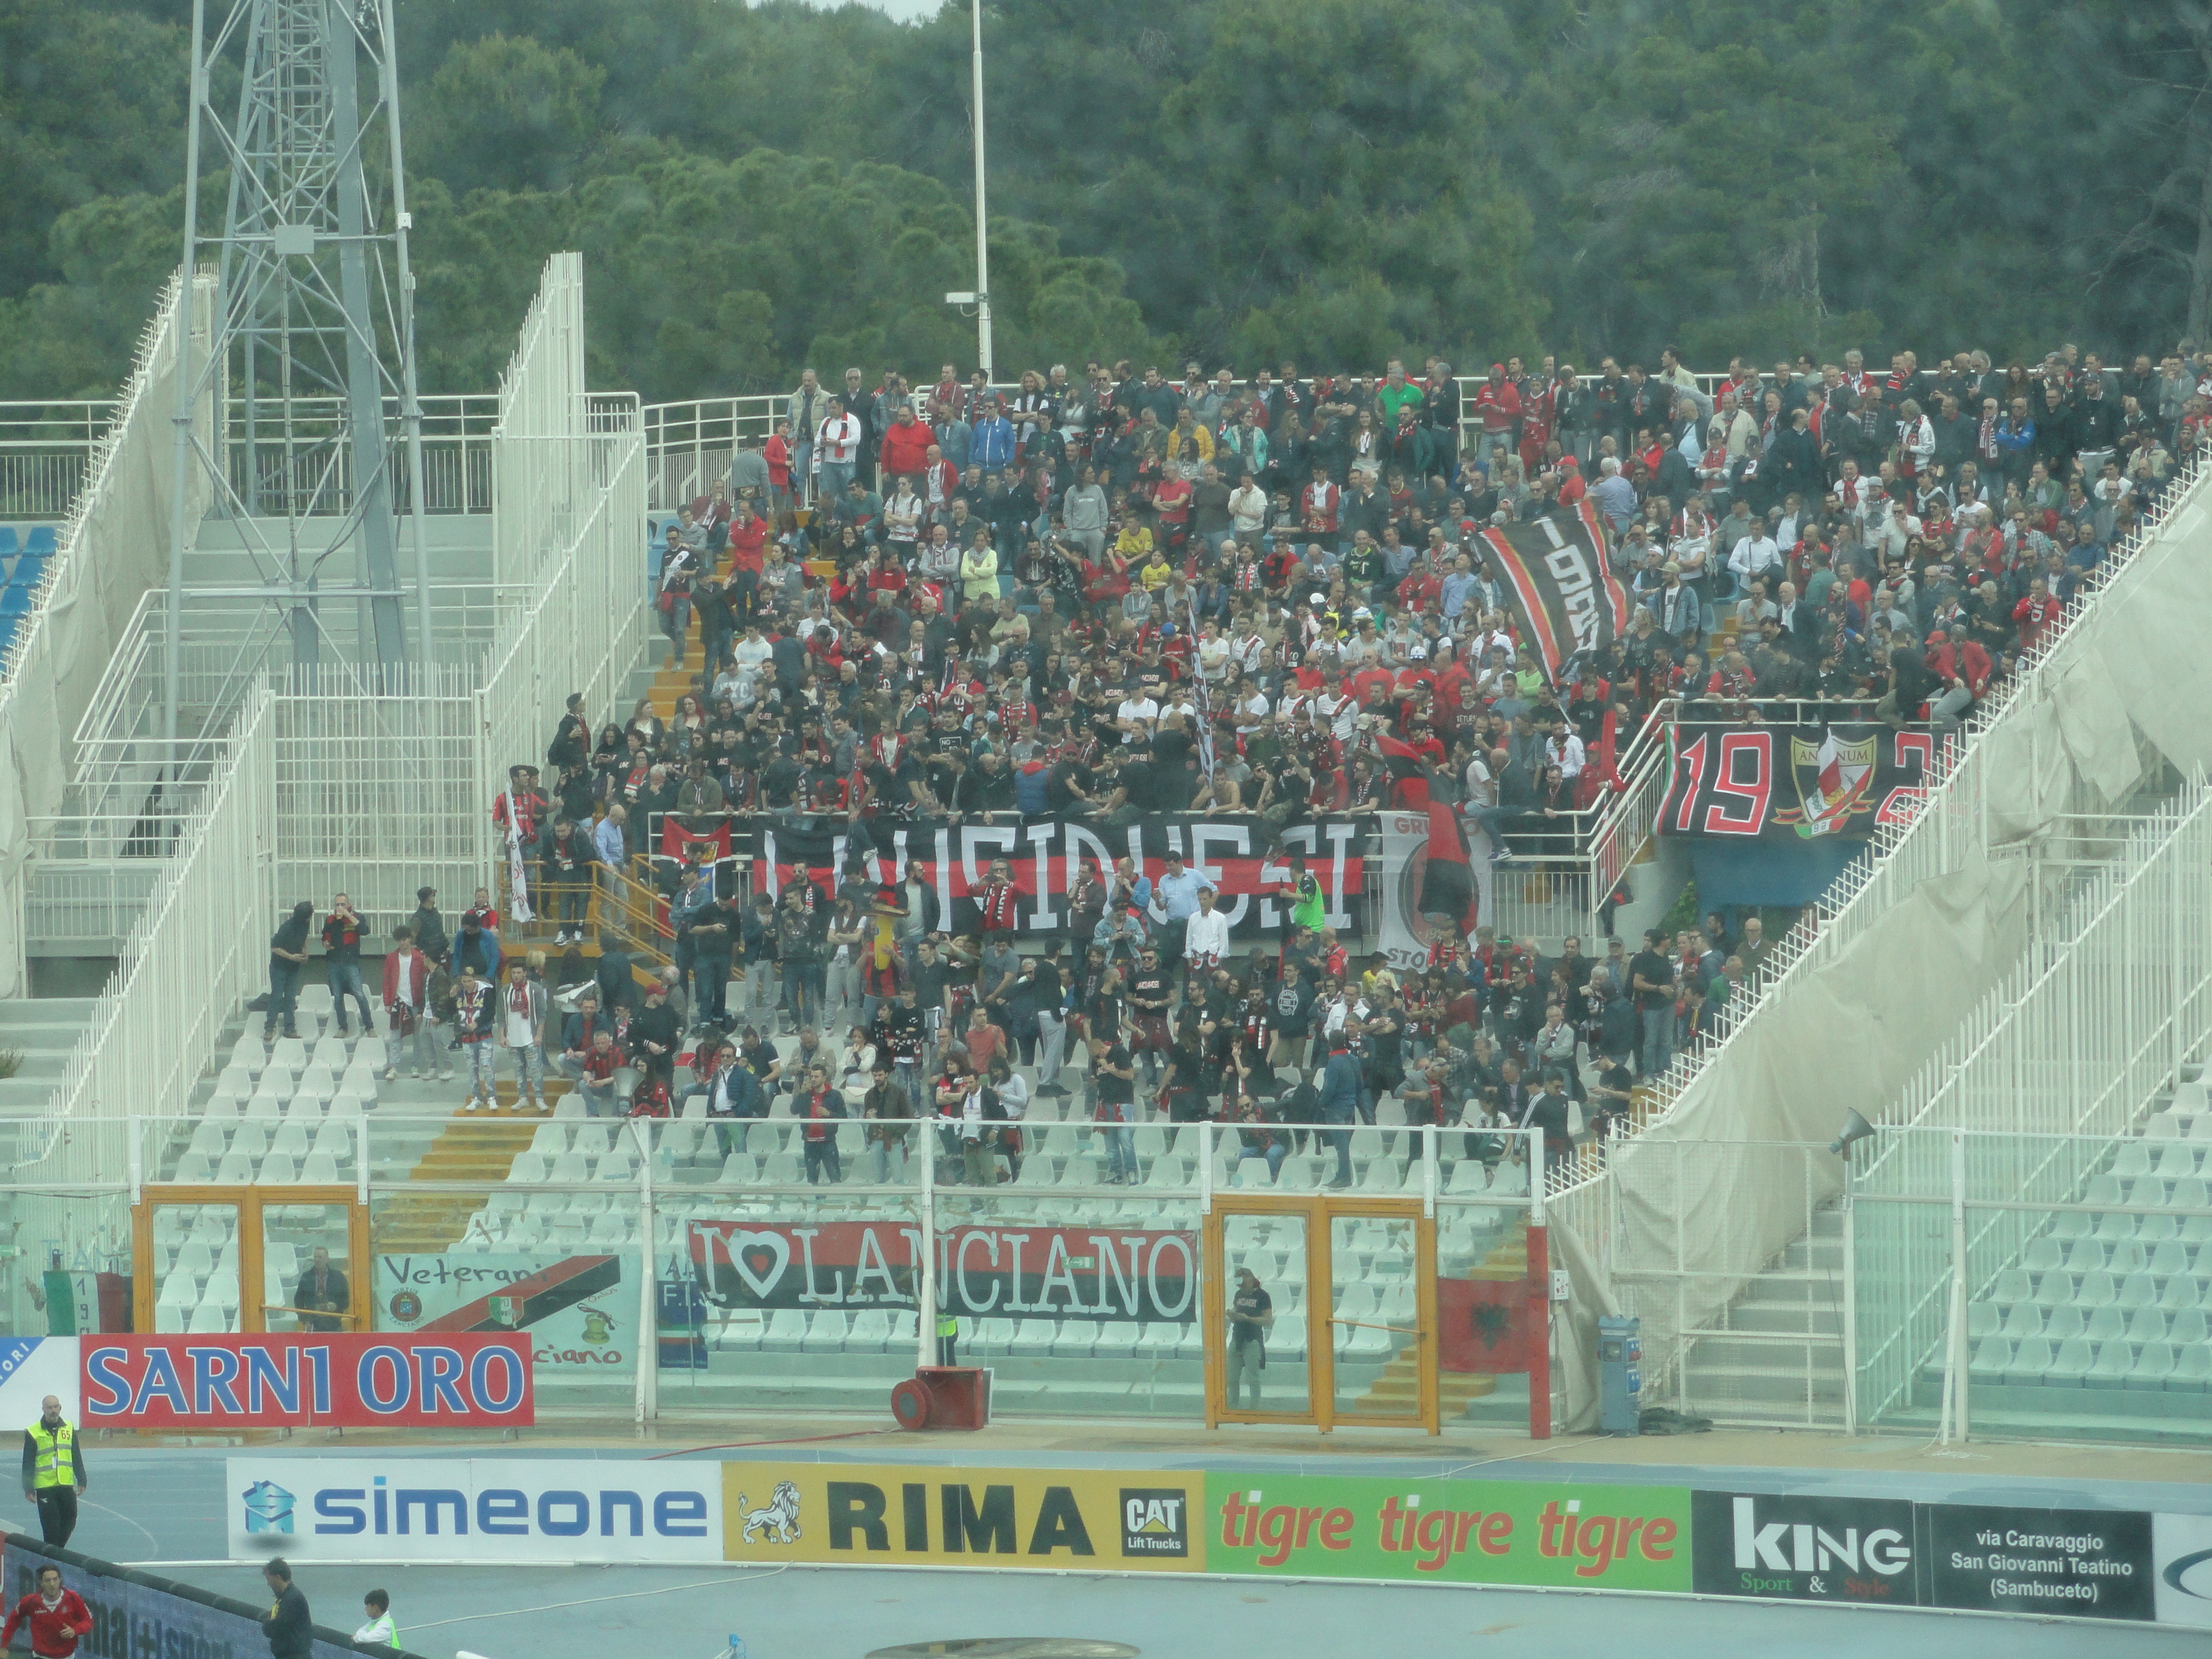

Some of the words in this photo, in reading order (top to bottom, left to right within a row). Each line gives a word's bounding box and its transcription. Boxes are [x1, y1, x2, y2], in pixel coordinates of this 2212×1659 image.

[384, 1256, 548, 1284] Veterani
[799, 1227, 1193, 1318] LANCIANO
[0, 1342, 30, 1380] ORI
[533, 1344, 623, 1364] ciano
[357, 1345, 526, 1415] ORO
[314, 1475, 708, 1537] simeone
[826, 1481, 1096, 1557] RIMA
[1127, 1498, 1180, 1533] CAT
[1128, 1537, 1145, 1548] Lift
[1146, 1537, 1181, 1549] Trucks
[1221, 1490, 1355, 1568] tigre
[1379, 1494, 1514, 1571] tigre
[1538, 1499, 1678, 1578] tigre
[1976, 1529, 2001, 1546] via
[2005, 1529, 2104, 1554] Caravaggio
[1951, 1552, 1983, 1570] San
[1988, 1554, 2064, 1573] Giovanni
[2068, 1557, 2133, 1576] Teatino
[1741, 1572, 1793, 1593] Sport
[1809, 1576, 1827, 1593] &
[1990, 1578, 2099, 1603] (Sambuceto)
